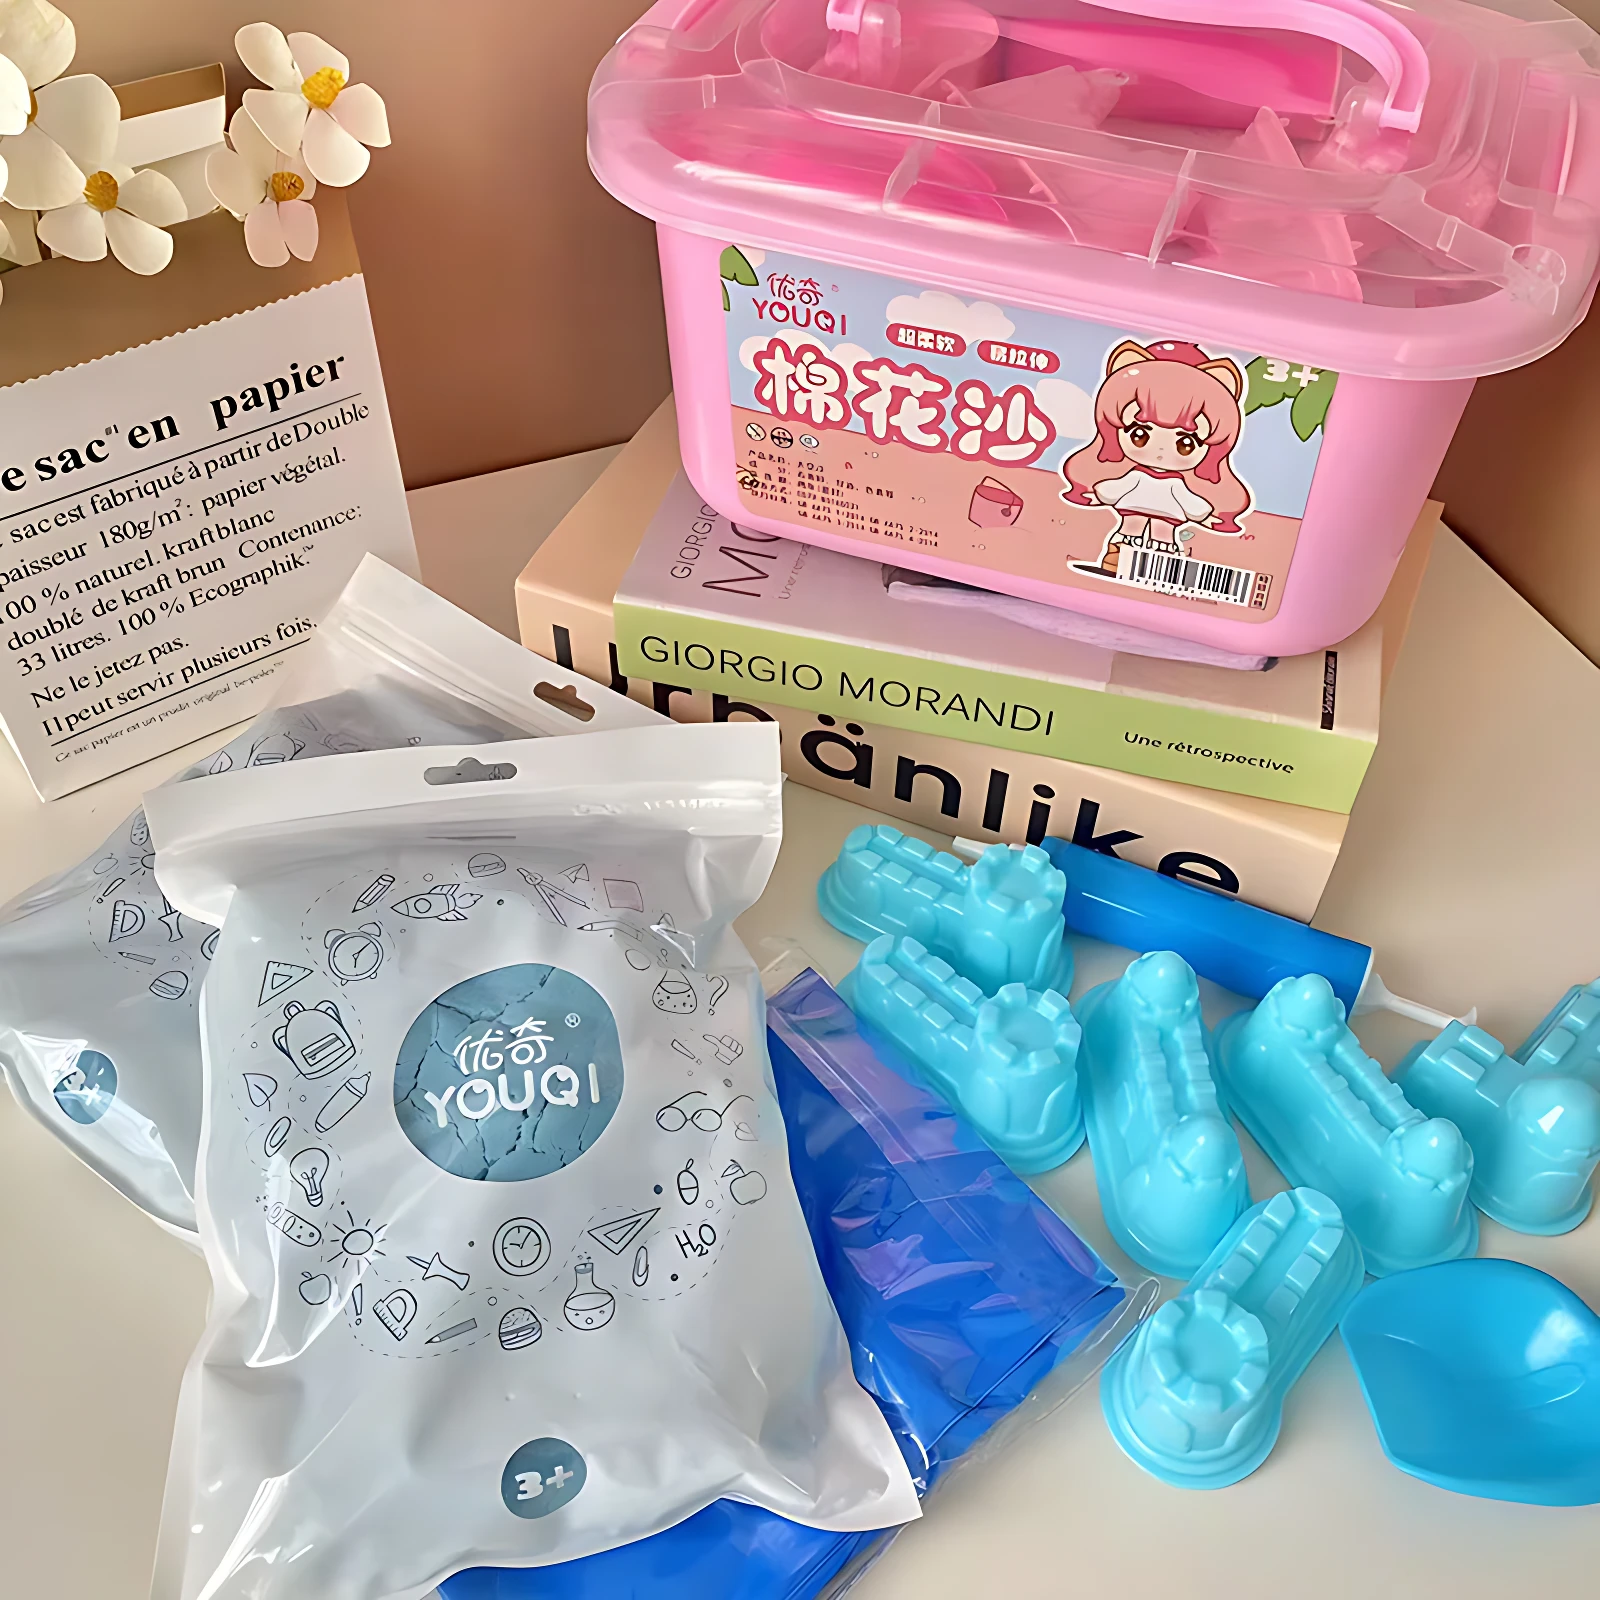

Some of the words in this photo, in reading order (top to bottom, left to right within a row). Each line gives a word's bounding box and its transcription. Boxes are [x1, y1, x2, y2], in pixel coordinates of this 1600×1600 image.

[752, 297, 847, 336] YOUQI
[767, 273, 823, 306] 优奇
[128, 415, 180, 448] en
[209, 356, 345, 431] papier
[757, 341, 1052, 464] 棉花沙
[1262, 358, 1319, 388] 3+
[10, 520, 51, 543] sac
[54, 504, 86, 527] est
[90, 465, 185, 514] fabriqué
[188, 461, 201, 479] à
[204, 441, 262, 479] partir
[266, 432, 293, 452] de
[293, 403, 370, 443] Double
[201, 478, 267, 516] papier
[271, 447, 346, 484] végétal.
[8, 608, 84, 650] doublé
[92, 598, 118, 617] de
[121, 573, 172, 606] kraft
[176, 557, 226, 584] brun
[238, 505, 362, 558] Contenance:
[42, 583, 70, 606] %
[162, 527, 215, 560] kraft
[215, 509, 276, 540] blanc
[17, 652, 46, 676] 33
[51, 632, 111, 662] litres.
[118, 607, 156, 636] 100
[159, 597, 185, 618] %
[30, 686, 66, 708] Ne
[69, 675, 90, 692] le
[94, 653, 145, 687] jetez
[148, 637, 189, 664] pas.
[65, 697, 114, 731] peut
[116, 672, 175, 705] servir
[181, 634, 271, 683] plusieurs
[640, 635, 823, 691] GIORGIO
[838, 671, 1055, 735] MORANDI
[1123, 731, 1162, 749] Une
[1167, 738, 1295, 775] rétrospective
[453, 1016, 554, 1075] 优奇
[424, 1062, 600, 1128] YOUQI
[514, 1465, 573, 1501] 3+
